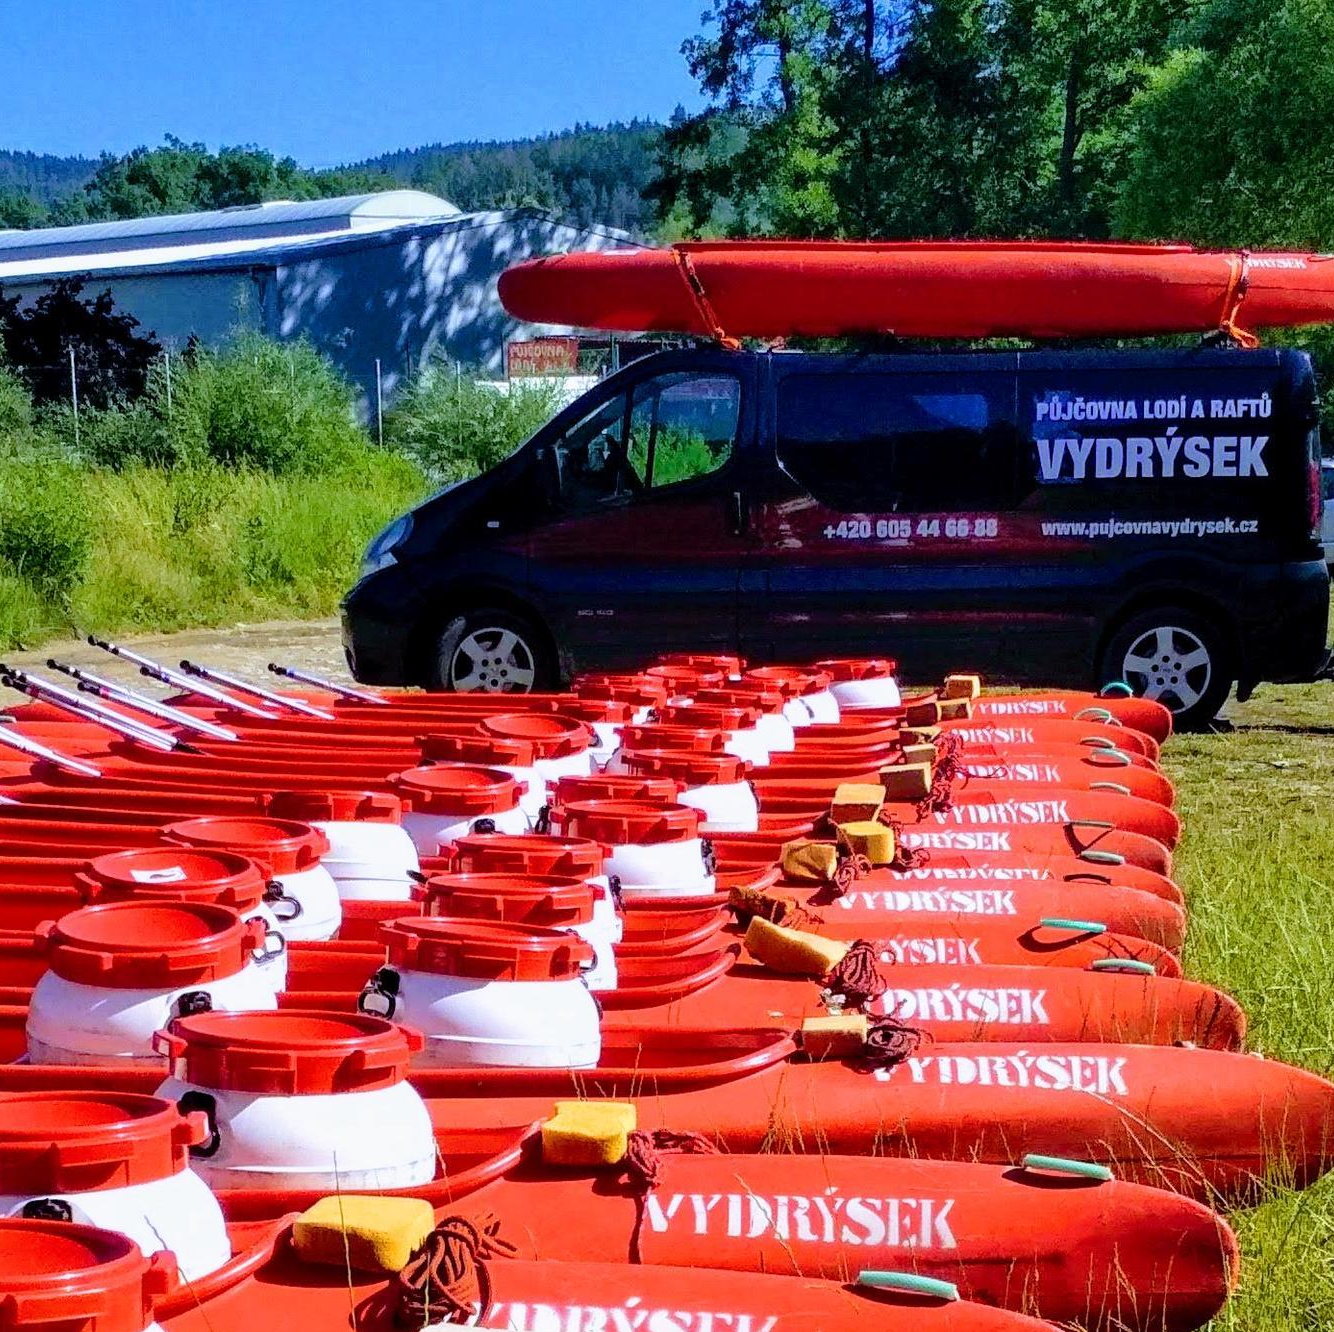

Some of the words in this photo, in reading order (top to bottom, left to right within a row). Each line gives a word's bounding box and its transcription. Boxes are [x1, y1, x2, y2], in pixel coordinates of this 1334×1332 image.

[1036, 396, 1138, 421] PŮJČOVNA
[1143, 395, 1186, 419] LODÍ
[1191, 399, 1205, 418] A
[1210, 391, 1272, 418] RAFTŮ
[1037, 426, 1269, 480] VYDRÝSEK
[824, 520, 871, 539] +420
[876, 519, 911, 538] 605
[917, 519, 940, 538] 44
[945, 518, 968, 537] 66
[974, 518, 998, 537] 88
[1041, 517, 1258, 538] www.pujcovnavydrysek.cz
[950, 725, 1035, 744] DRÝSEK
[863, 983, 1051, 1024] DRÝSEK
[643, 1187, 957, 1250] VYDRÝSEK
